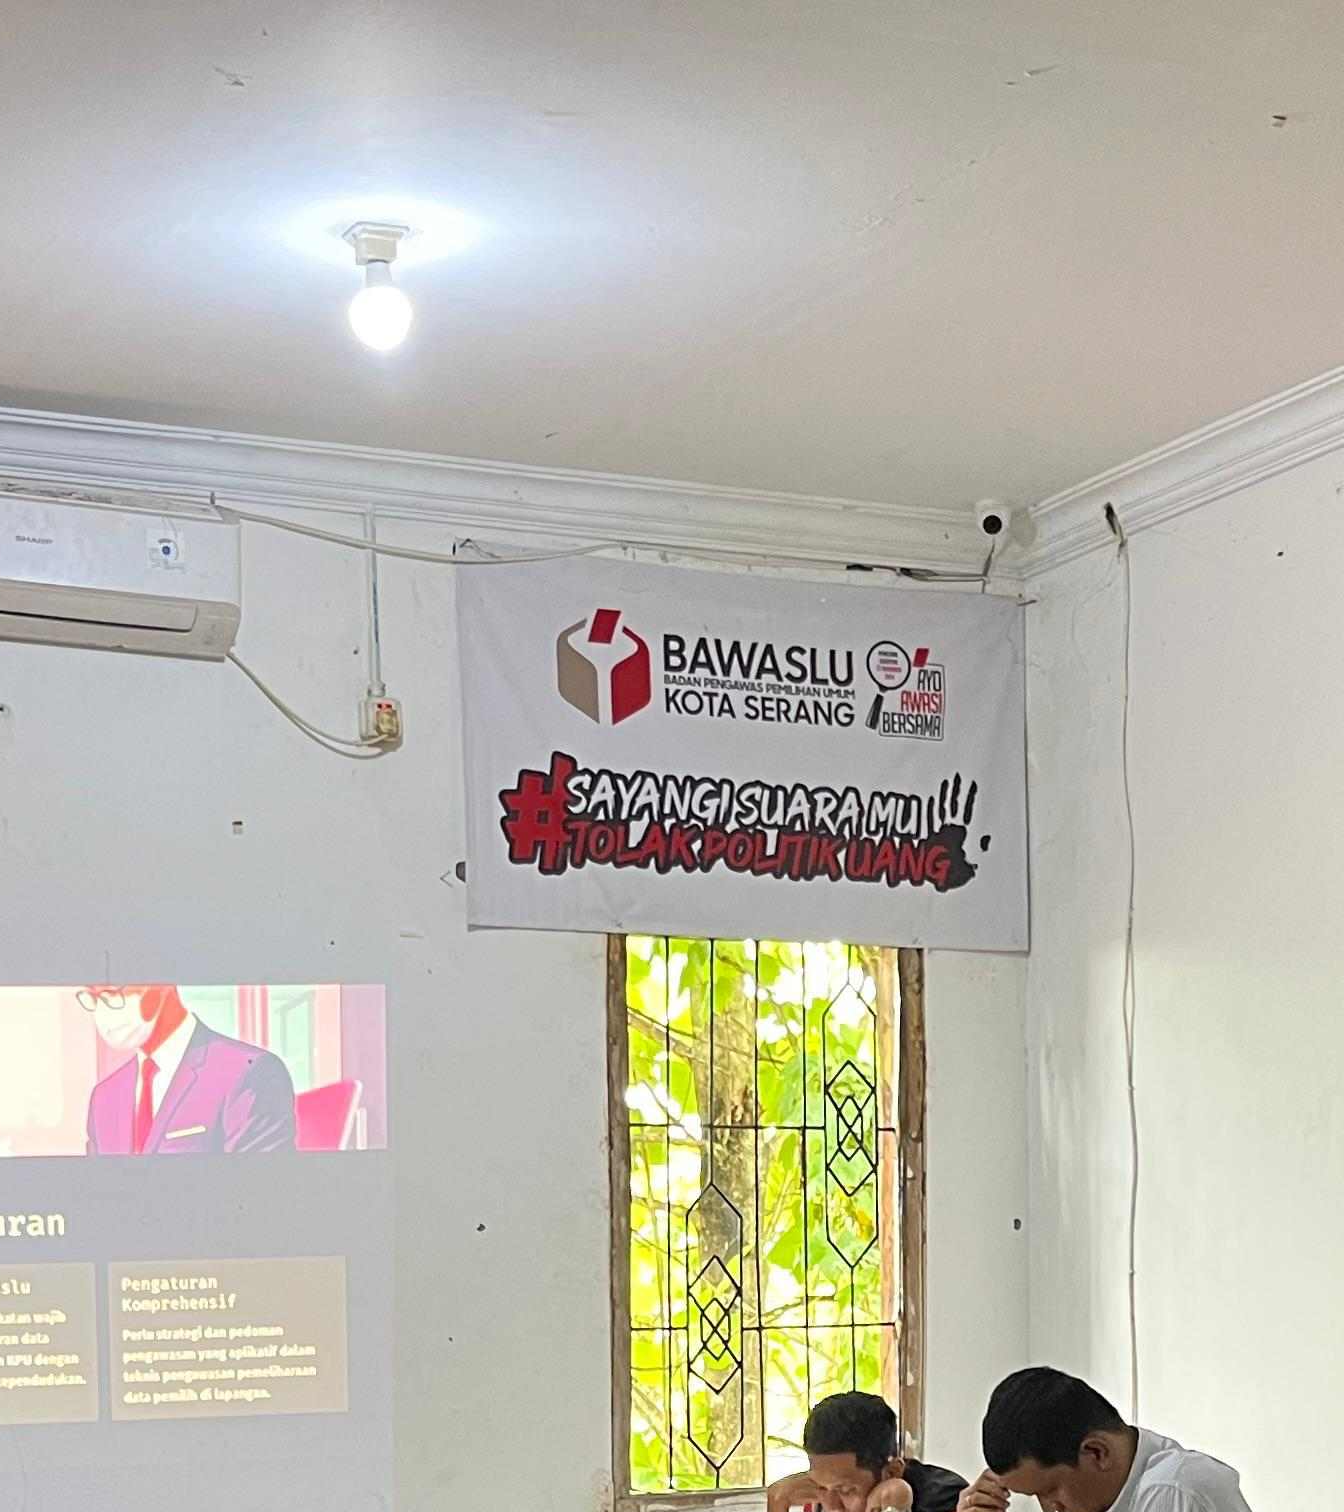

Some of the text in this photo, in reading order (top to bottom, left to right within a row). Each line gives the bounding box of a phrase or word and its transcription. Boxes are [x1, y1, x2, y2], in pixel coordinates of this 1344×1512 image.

[663, 634, 854, 687] BAWASLU
[664, 674, 855, 700] BADAN PENGAWAS PEMILIHAN UMUM
[917, 669, 942, 692] AYO
[664, 688, 855, 728] KOTA SERANG
[900, 690, 942, 714] AWASI
[882, 712, 941, 737] BERSAMA
[121, 1277, 217, 1294] Pengaturan
[121, 1293, 236, 1314] Komprehensif
[20, 1332, 50, 1345] data
